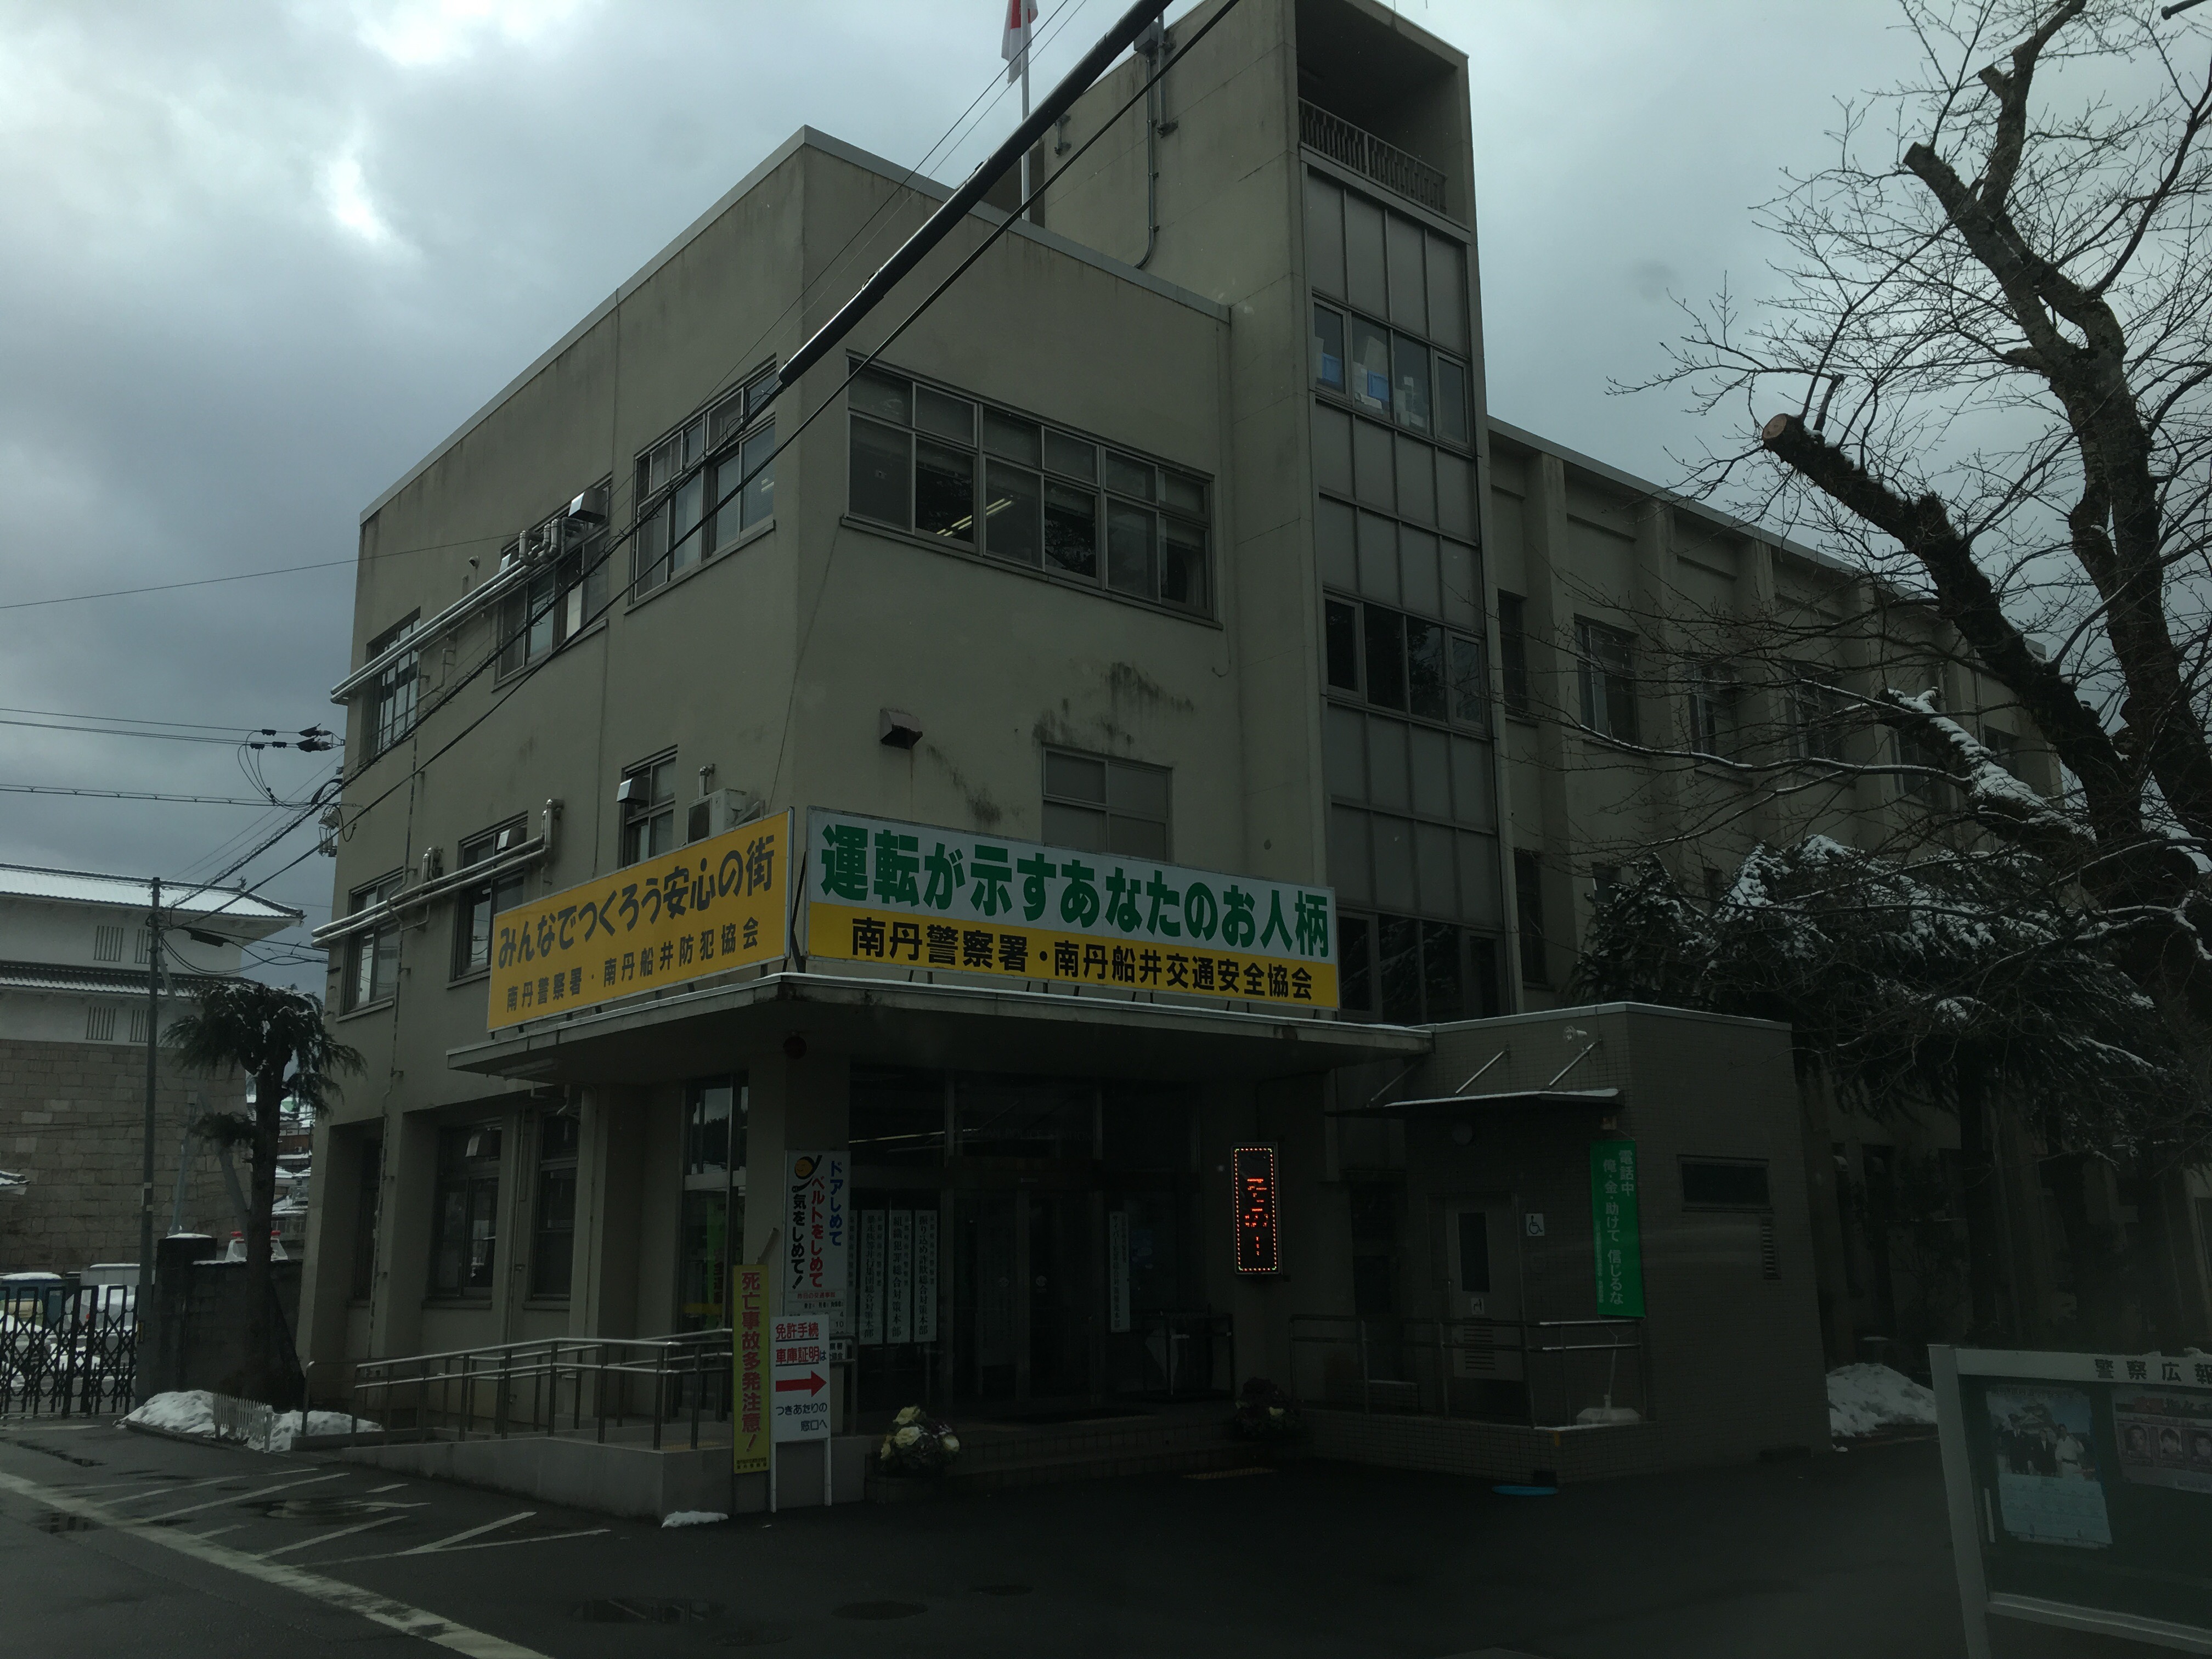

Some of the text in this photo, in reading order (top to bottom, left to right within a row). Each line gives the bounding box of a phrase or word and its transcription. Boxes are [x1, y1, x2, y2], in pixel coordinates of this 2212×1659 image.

[498, 834, 775, 969] みんなでつくろう安心の街
[821, 824, 1328, 958] 運転が示すあなたのお人柄
[506, 917, 759, 1013] 南丹警察署・南丹船井防犯協会
[852, 916, 1312, 1001] 南丹警察署・南丹船井交通安全協会
[829, 1160, 844, 1246] ドアしめて
[1618, 1149, 1634, 1197] 電話中
[791, 1193, 807, 1290] 気をしめて！
[809, 1176, 825, 1288] ベルトをしめて
[892, 1216, 903, 1338] 組織犯罪総合対策本部
[1607, 1249, 1624, 1305] 信じるな
[741, 1272, 761, 1452] 死亡事故多発注意！
[775, 1322, 819, 1339] 免許手続
[775, 1345, 827, 1364] 車庫証明は
[775, 1402, 828, 1417] つきあたりの
